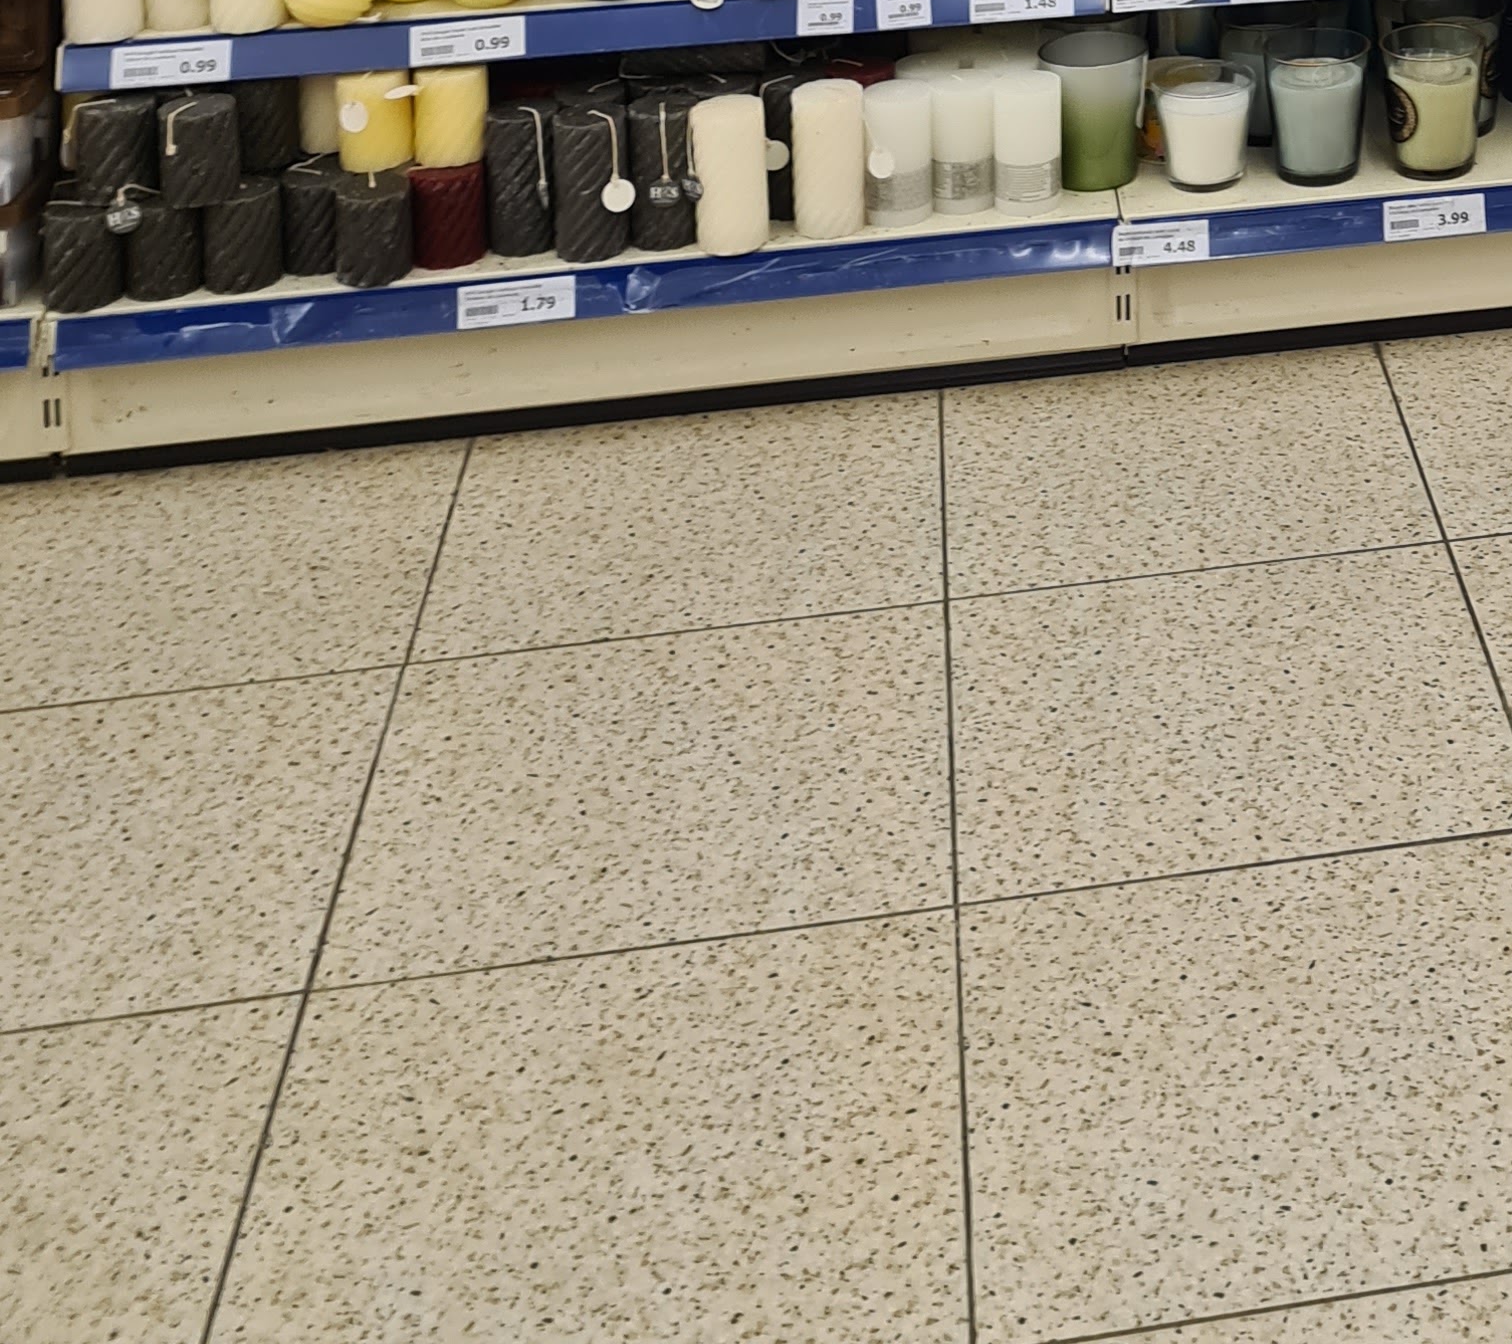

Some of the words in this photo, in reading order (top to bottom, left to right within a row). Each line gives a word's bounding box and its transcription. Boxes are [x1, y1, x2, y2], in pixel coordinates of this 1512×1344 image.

[475, 36, 510, 51] 0.99
[180, 59, 216, 73] 0.99
[1438, 212, 1469, 225] 3.99
[521, 296, 555, 311] 1.79
